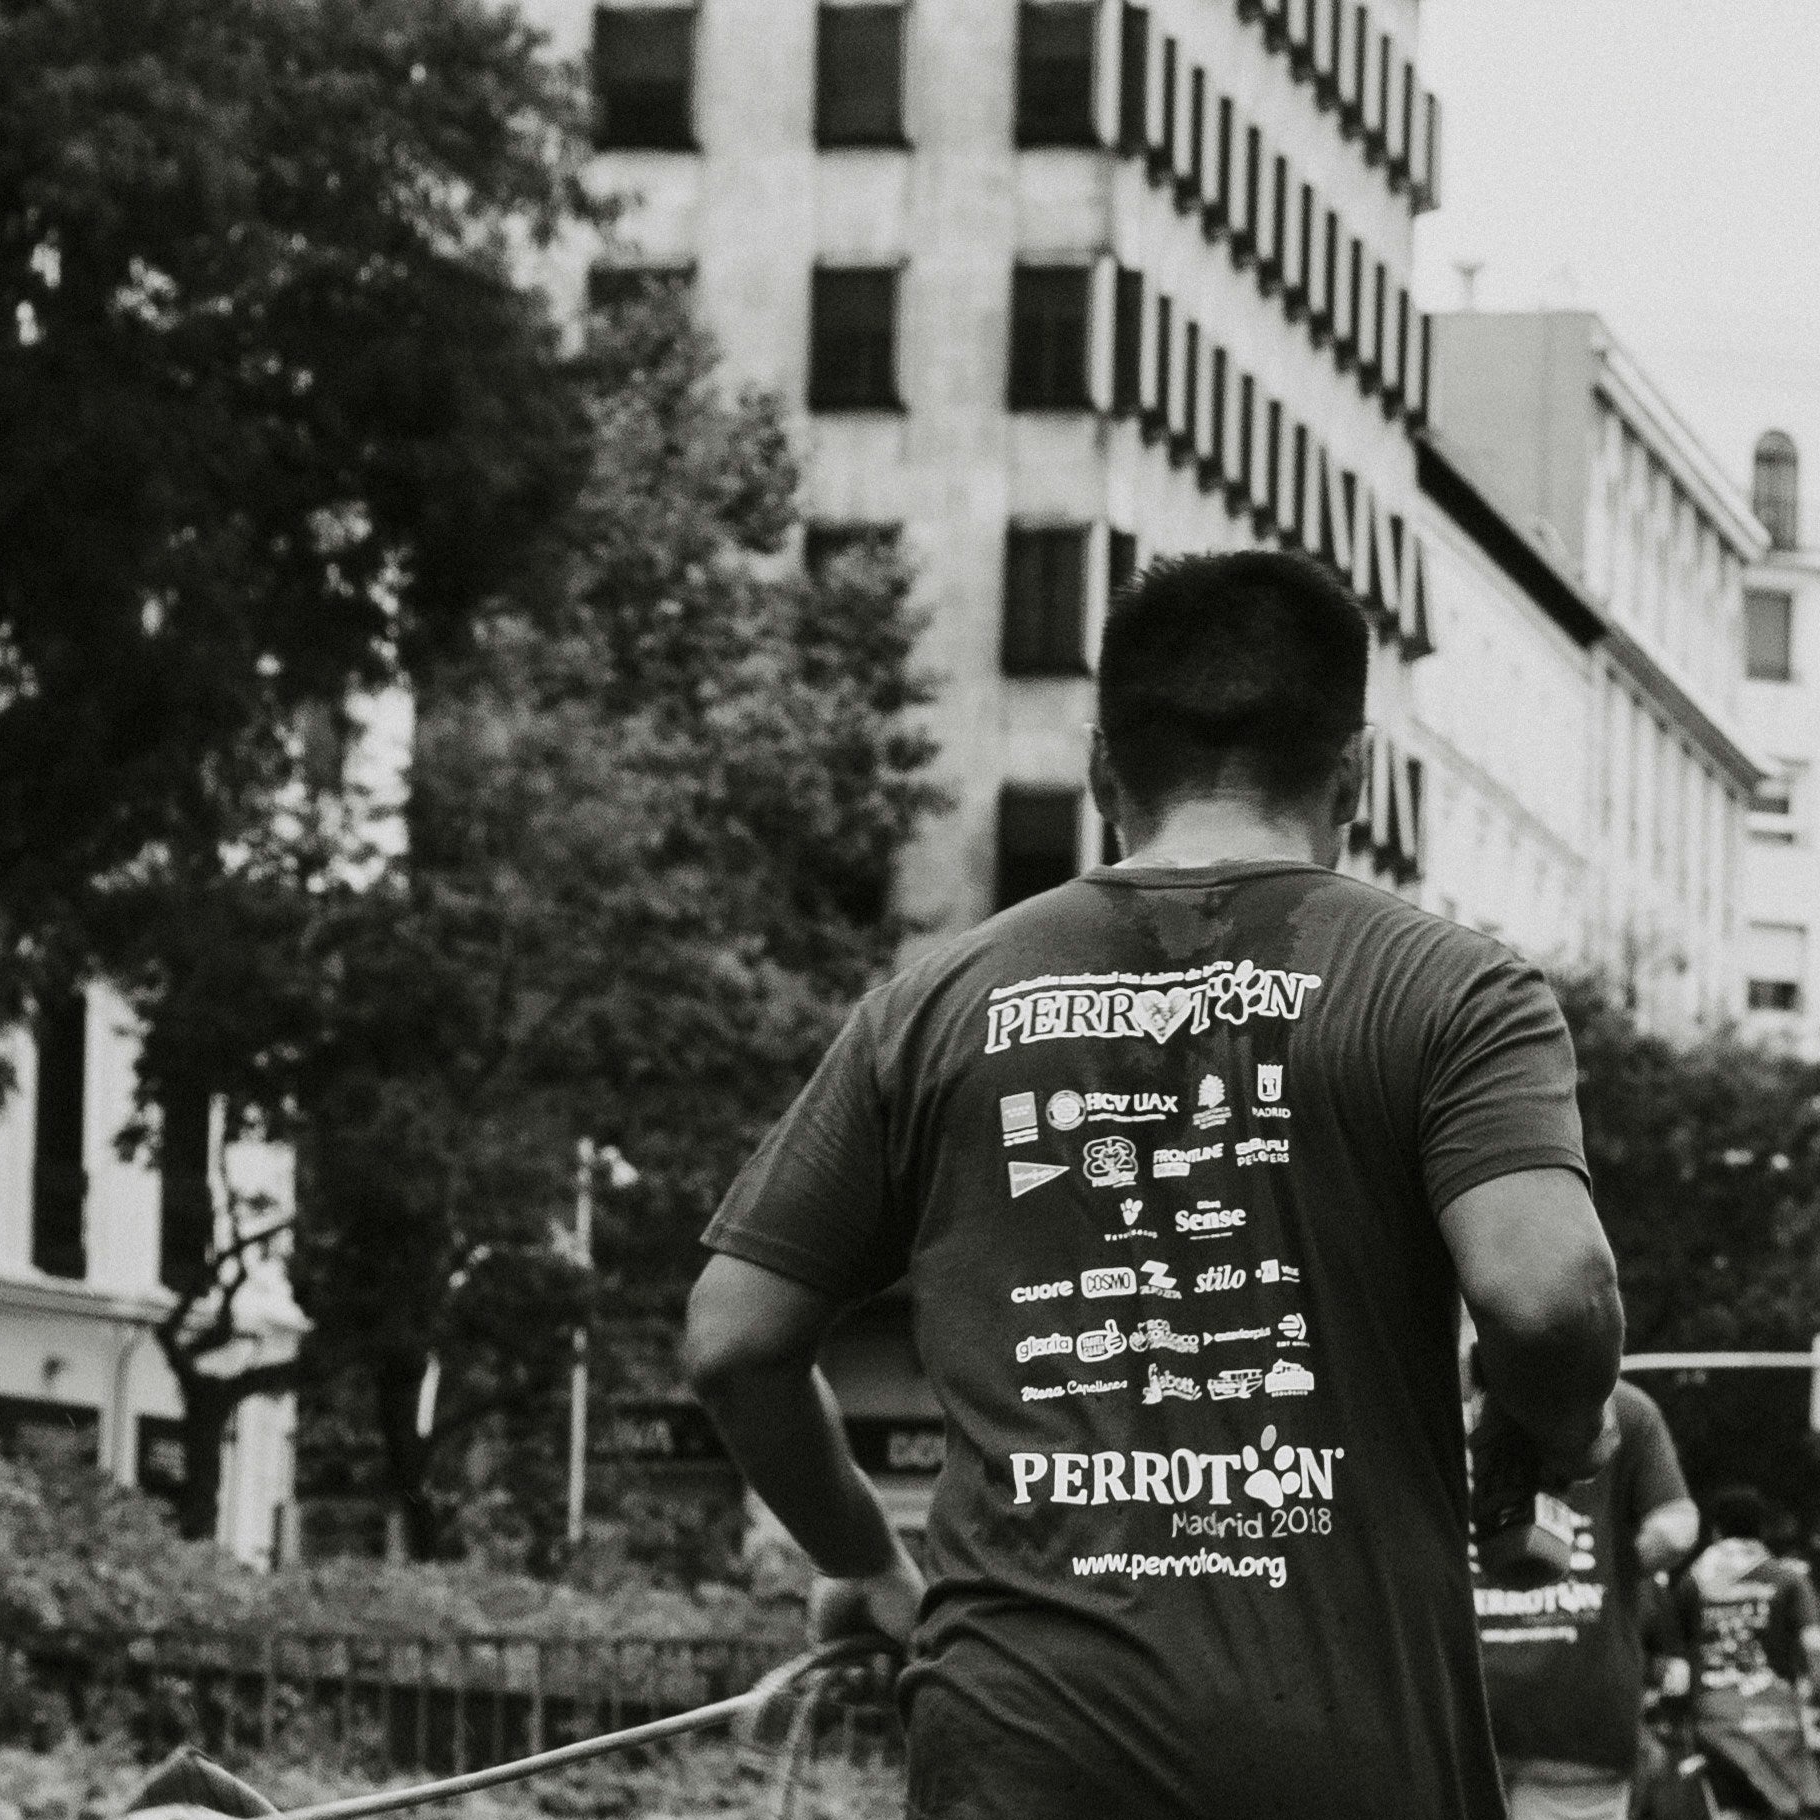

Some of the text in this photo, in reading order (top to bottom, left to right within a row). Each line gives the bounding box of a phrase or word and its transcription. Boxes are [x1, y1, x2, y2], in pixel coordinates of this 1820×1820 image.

[1084, 1091, 1131, 1112] HCV
[1133, 1092, 1179, 1113] UAX
[1175, 1208, 1247, 1232] Sense
[1010, 1280, 1074, 1303] cuore
[1194, 1264, 1247, 1293] stilo
[1172, 1507, 1333, 1539] Madrid 2018
[1072, 1547, 1287, 1588] www.perroton.org
